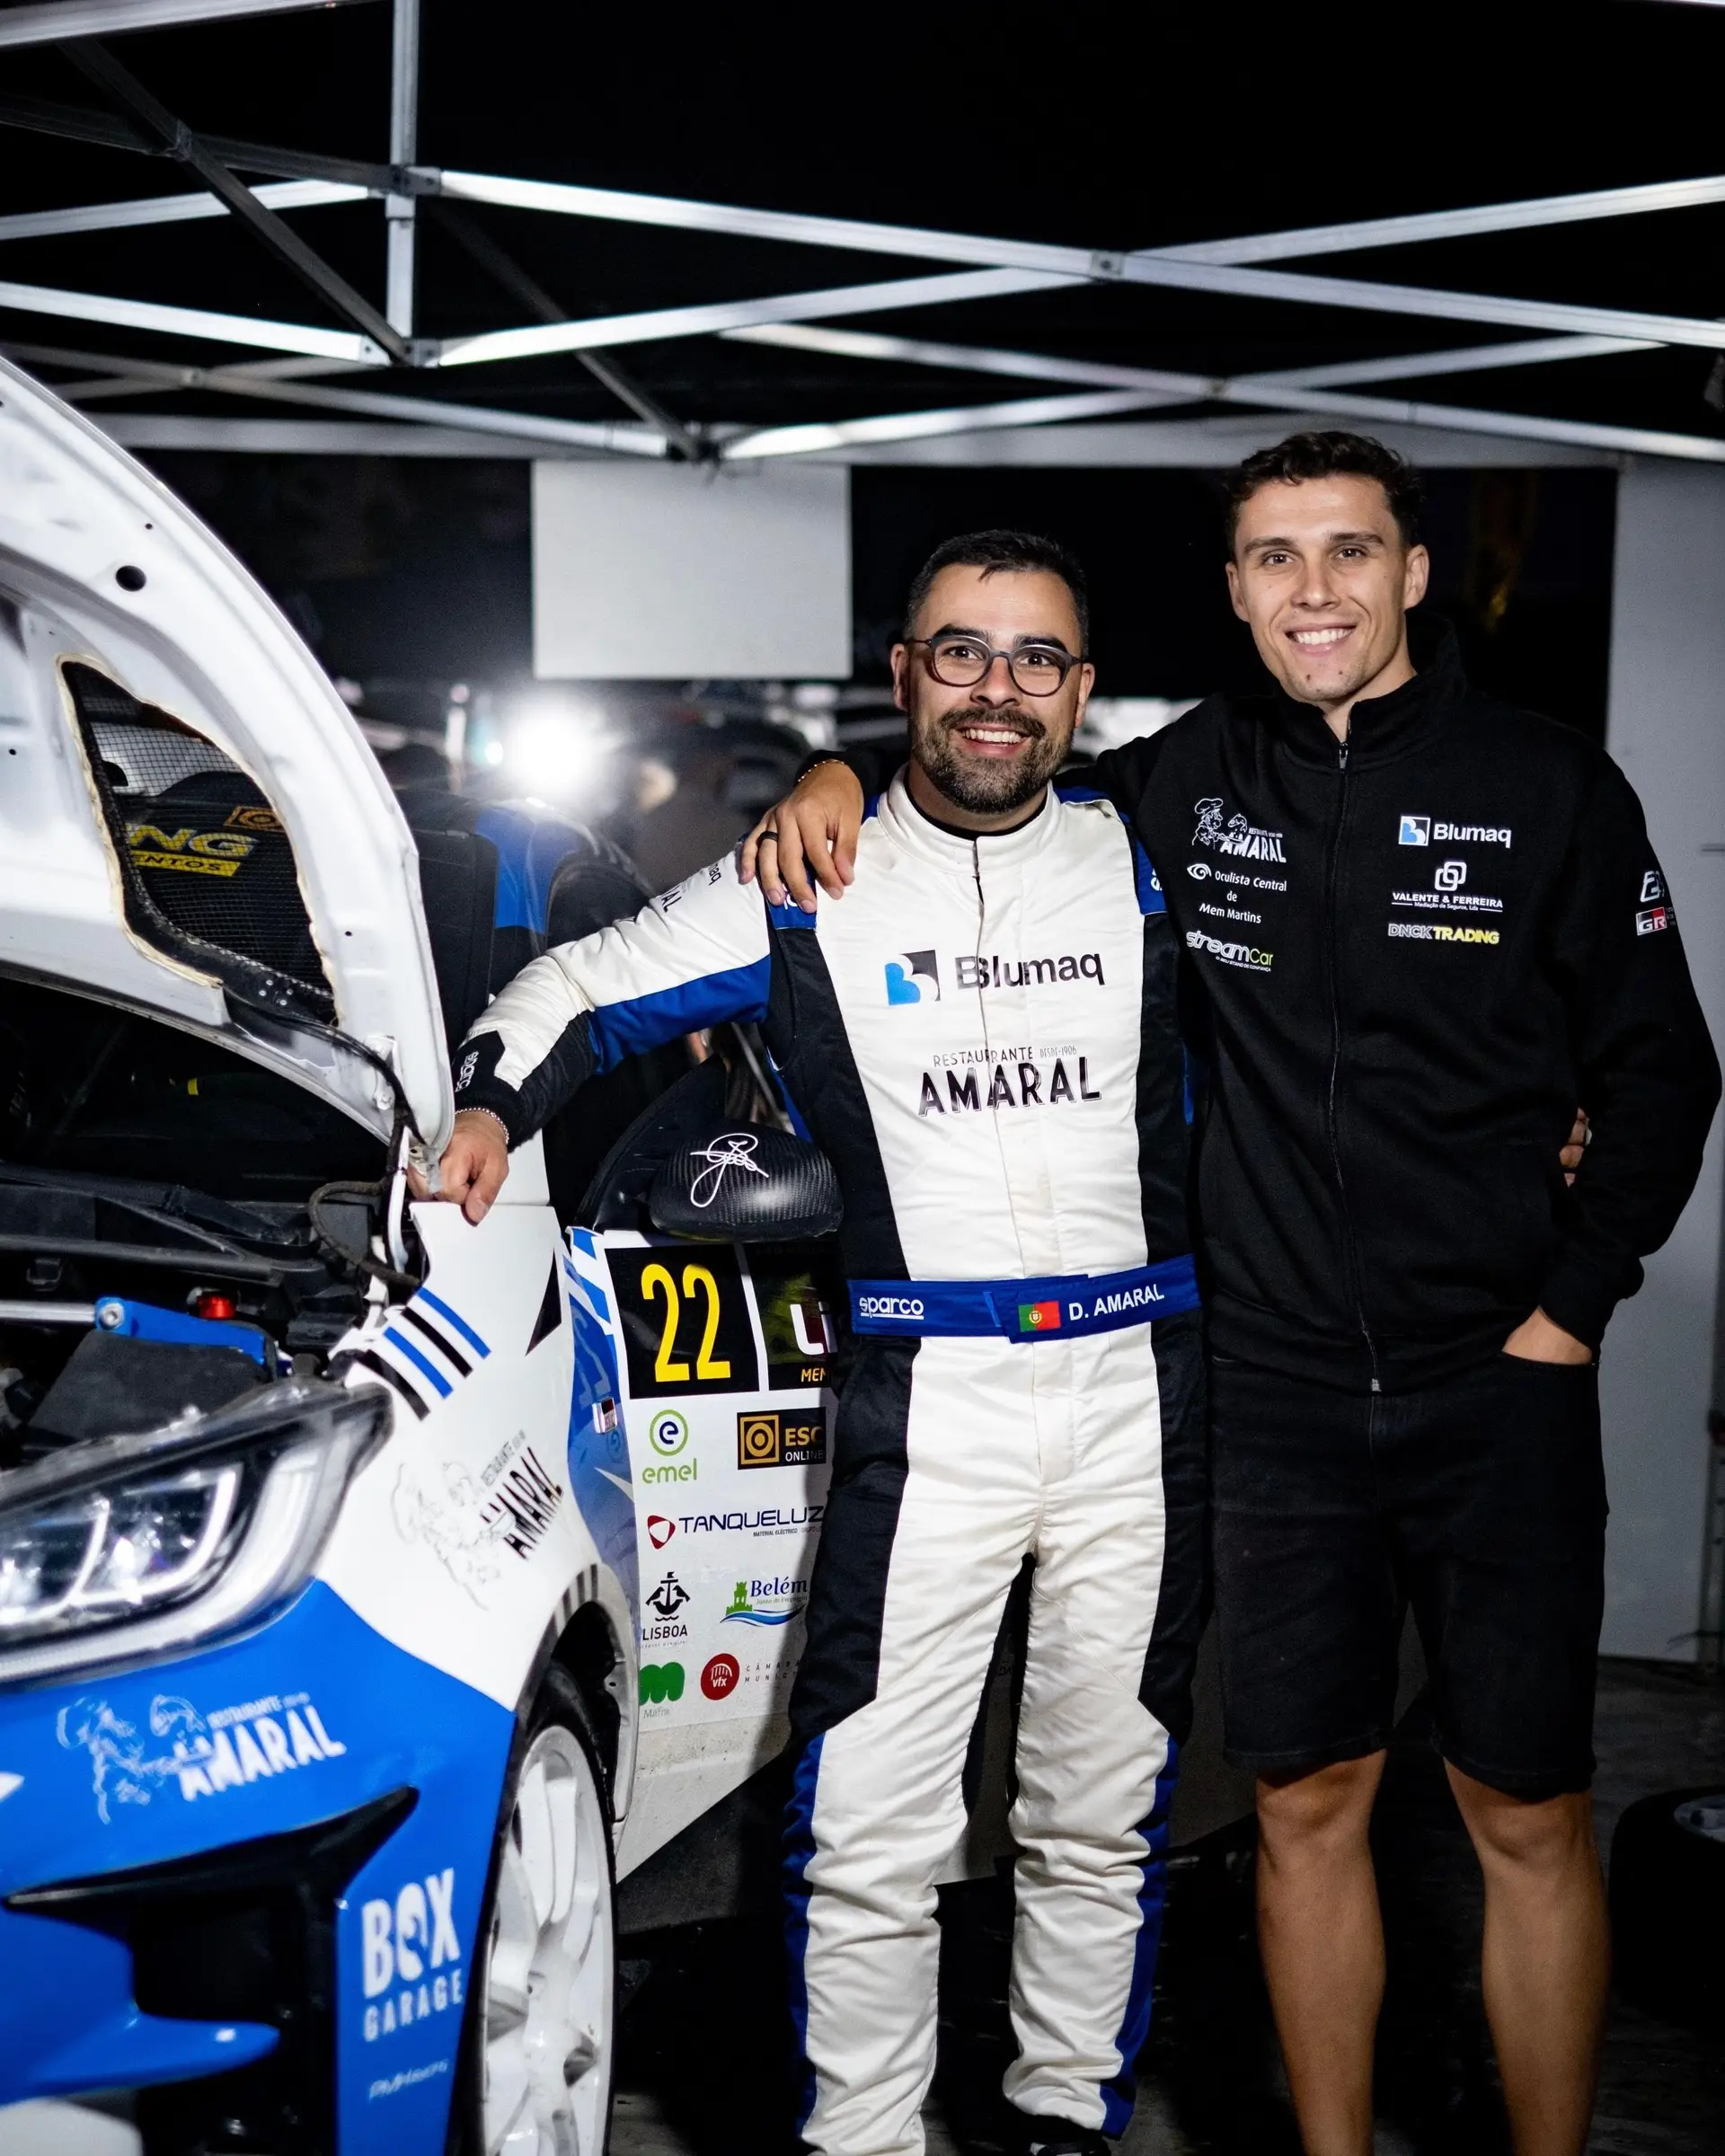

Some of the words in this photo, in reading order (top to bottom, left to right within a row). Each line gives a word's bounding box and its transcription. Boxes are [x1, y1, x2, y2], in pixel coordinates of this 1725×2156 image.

[1220, 832, 1287, 862] AMARAL
[1433, 823, 1512, 849] Blumaq
[1215, 870, 1251, 886] Oculista
[1252, 877, 1287, 892] Central
[1226, 890, 1238, 902] de
[1392, 892, 1440, 904] VALENTE
[1442, 895, 1450, 904] &
[1453, 896, 1504, 908] FERREIRA
[1199, 903, 1225, 917] Mem
[1227, 908, 1262, 924] Martins
[1638, 915, 1666, 933] GR
[954, 952, 1105, 990] Blumaq
[917, 1056, 1102, 1118] AMARAL
[859, 1296, 924, 1319] sparco
[1068, 1302, 1089, 1321] D.
[1093, 1283, 1165, 1317] AMARAL
[641, 1263, 731, 1383] 22
[784, 1449, 824, 1462] ONLINE
[641, 1457, 697, 1484] emel
[678, 1505, 825, 1534] TANQUELUZ
[750, 1576, 808, 1597] Belém
[642, 1624, 688, 1640] LISBOA
[712, 1677, 727, 1688] vfx
[172, 1704, 348, 1802] AMARAL
[362, 1868, 461, 2000] BOX
[363, 1968, 464, 2043] GARAGE
